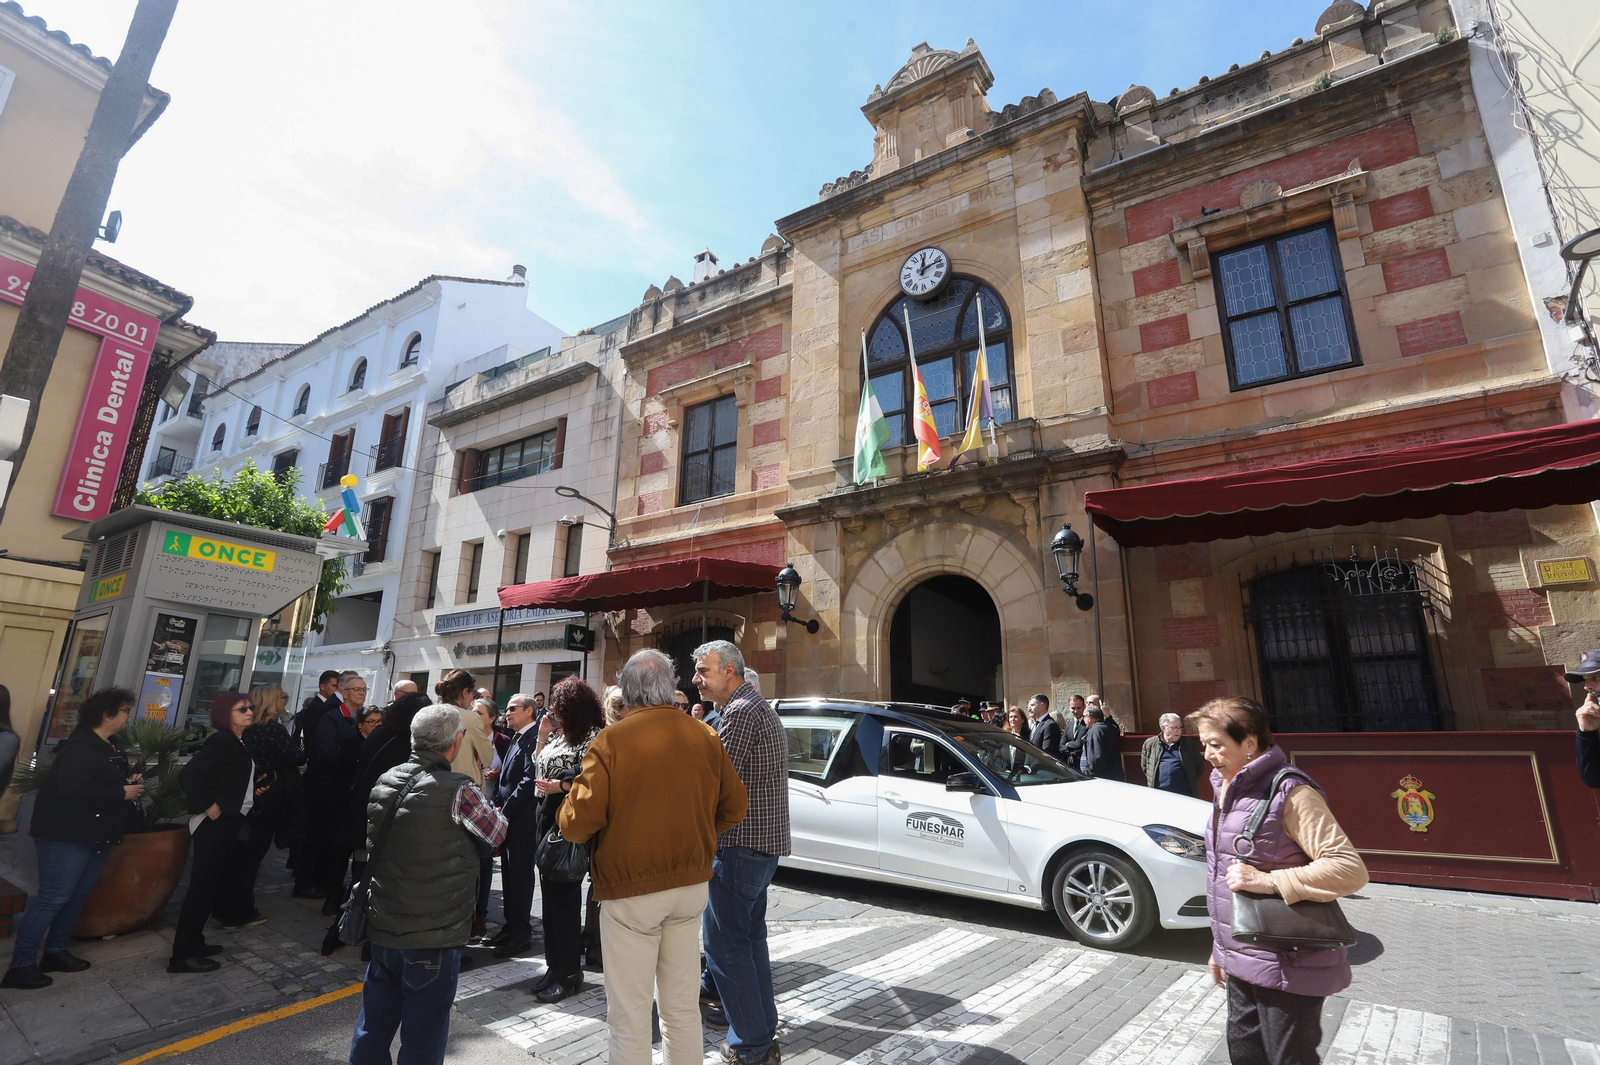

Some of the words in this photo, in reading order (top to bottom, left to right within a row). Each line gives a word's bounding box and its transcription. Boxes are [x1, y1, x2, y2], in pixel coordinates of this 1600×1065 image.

[852, 224, 888, 250] CASA
[93, 308, 119, 330] 70
[124, 322, 148, 341] 01
[73, 431, 114, 512] Clinica
[97, 349, 136, 425] Dental
[199, 542, 267, 568] ONCE
[1555, 562, 1574, 570] CALLE
[99, 577, 123, 597] ONCE
[436, 614, 471, 629] GABINETE
[472, 613, 483, 625] DE
[485, 608, 522, 623] ASEORIA
[906, 818, 965, 839] FUNESMAR
